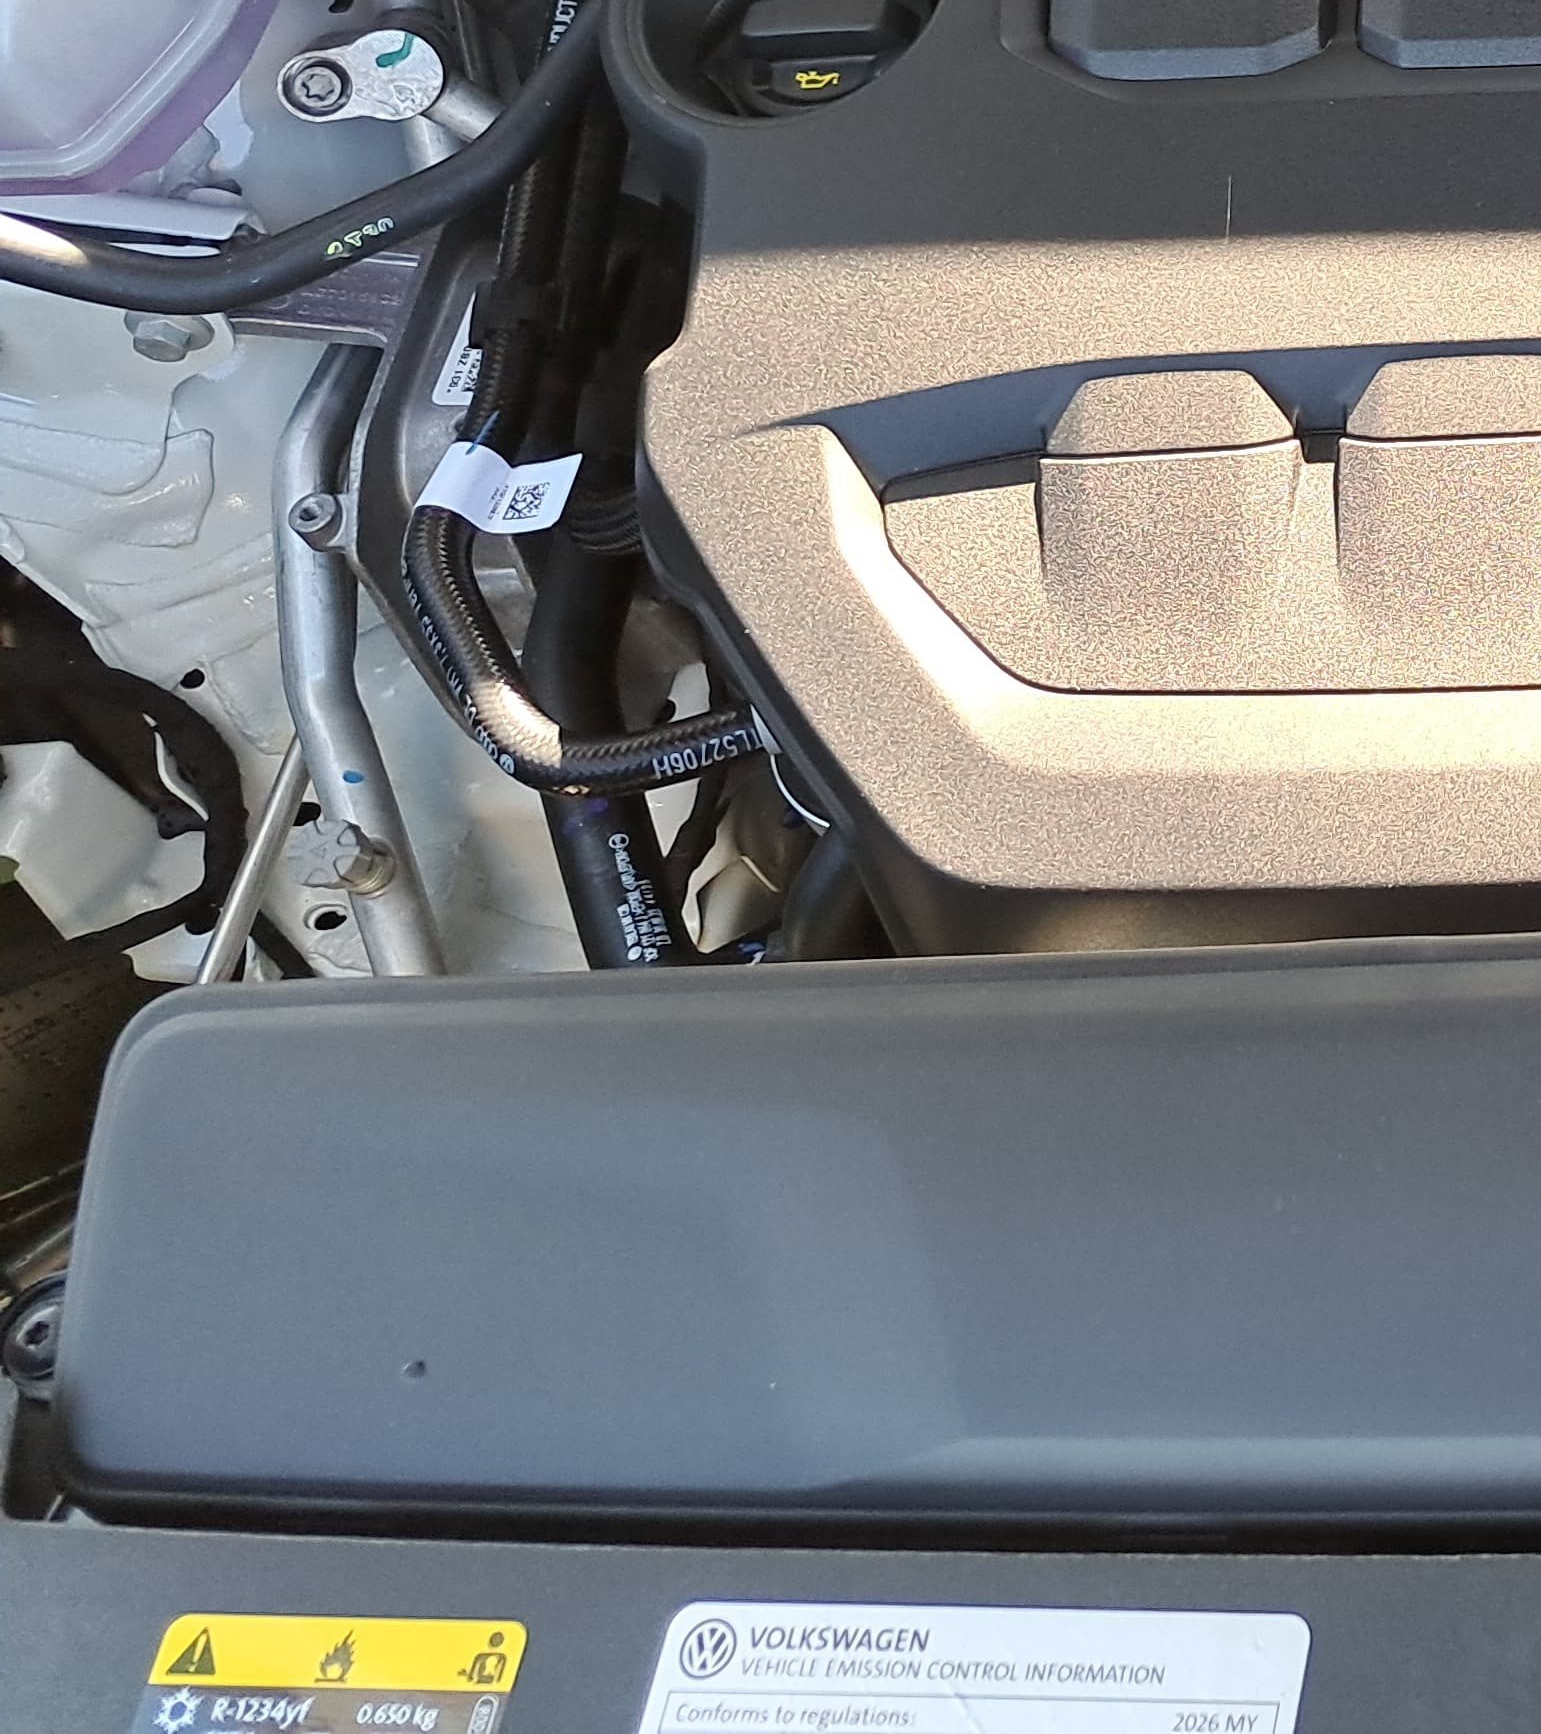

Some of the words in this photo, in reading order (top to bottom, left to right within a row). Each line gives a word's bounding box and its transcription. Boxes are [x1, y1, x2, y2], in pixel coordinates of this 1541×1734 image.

[750, 1626, 930, 1652] VOLKSWAGEN
[741, 1657, 817, 1678] VEHICLE
[825, 1658, 923, 1679] EMISSION
[926, 1660, 1017, 1681] CONTROL
[1025, 1662, 1165, 1685] INFORMATION
[211, 1696, 316, 1730] R-1234yf
[356, 1702, 412, 1725] 0.650
[412, 1702, 440, 1731] kg
[676, 1703, 768, 1723] Conforms
[775, 1705, 794, 1724] to
[1172, 1712, 1220, 1733] 2026
[1226, 1713, 1258, 1733] MY
